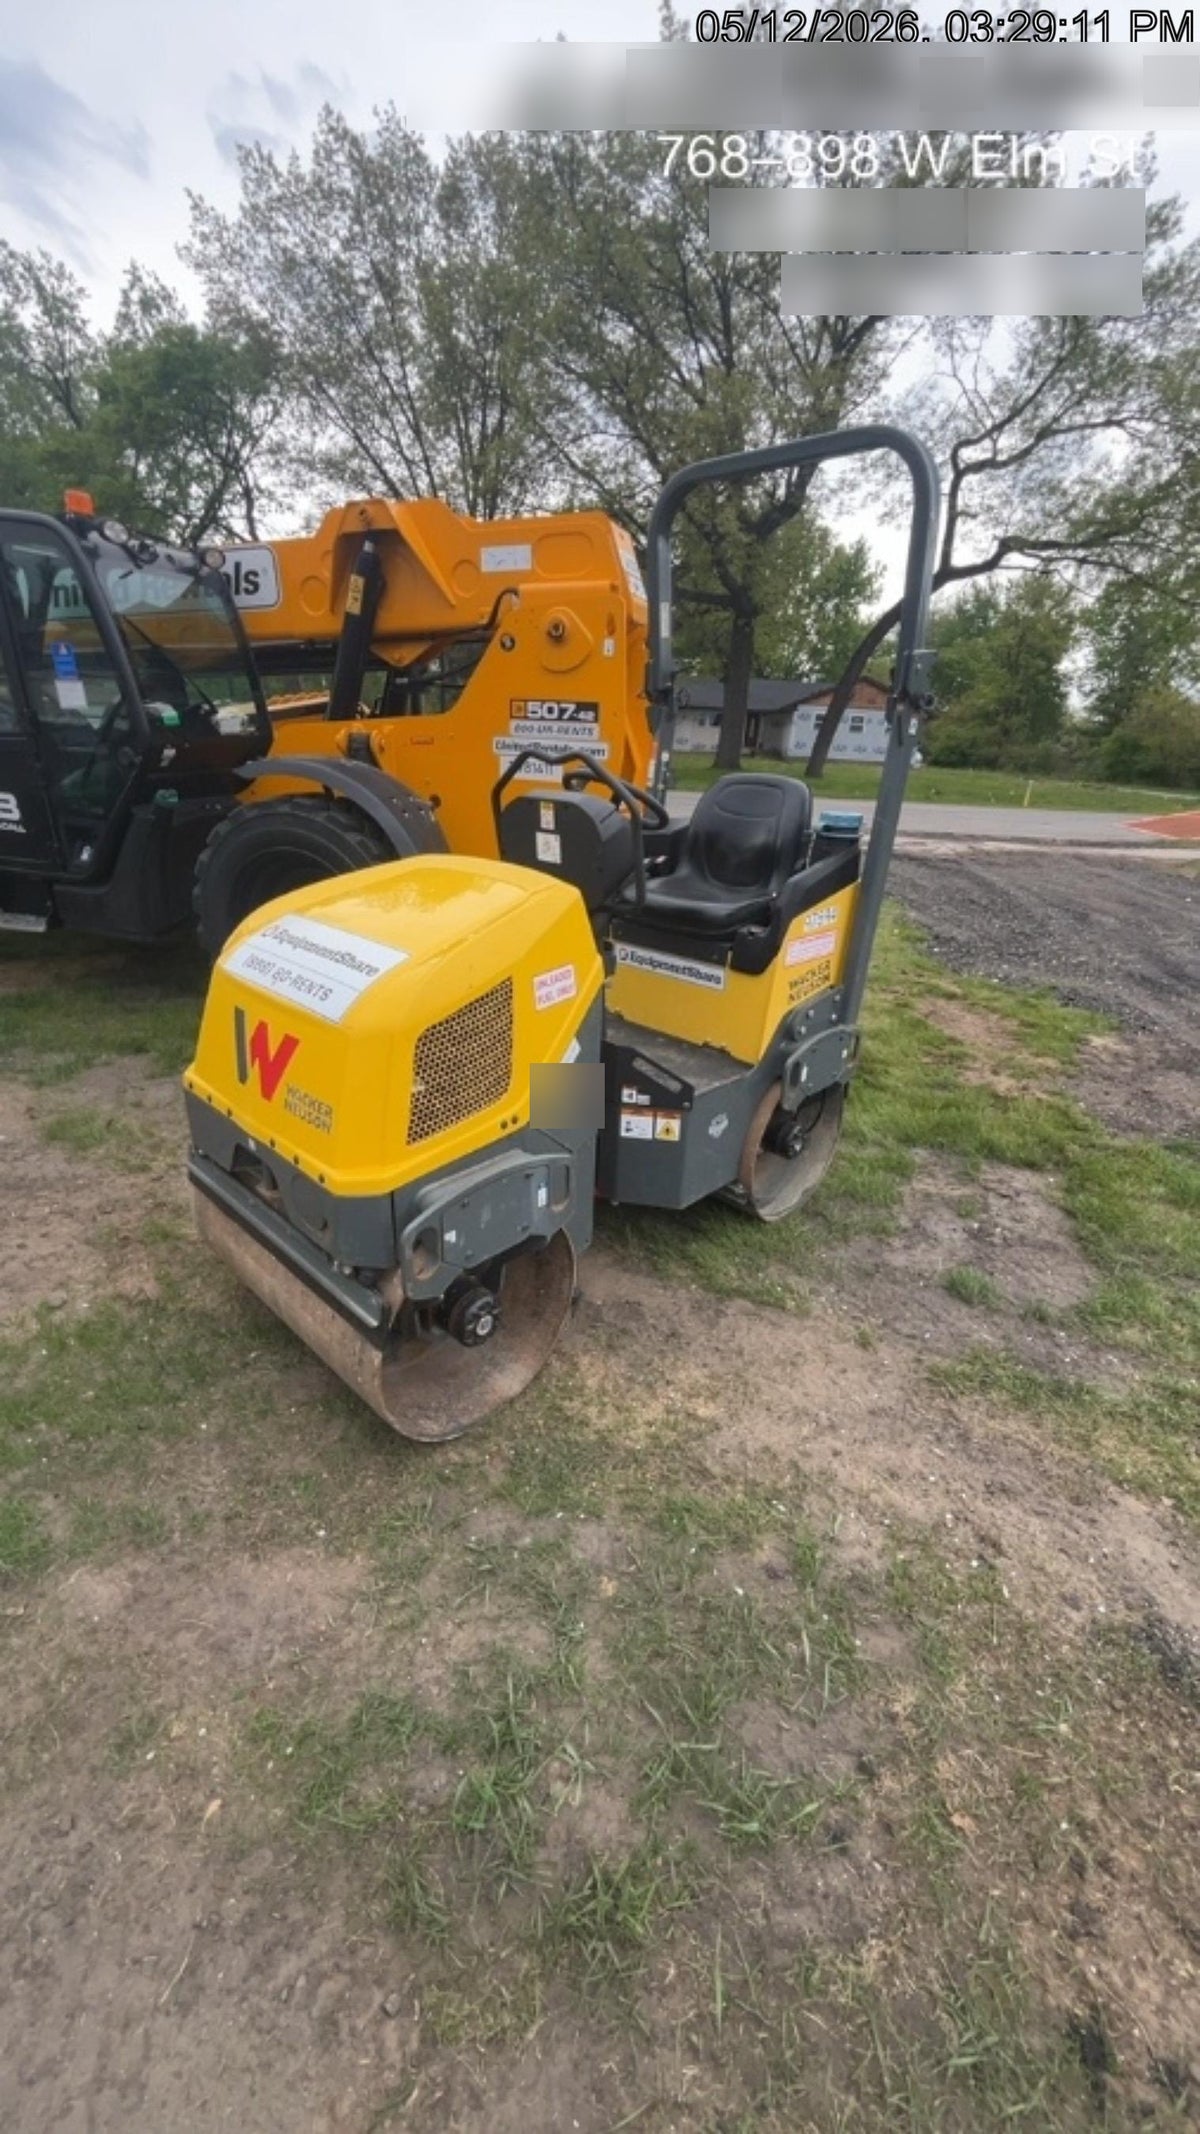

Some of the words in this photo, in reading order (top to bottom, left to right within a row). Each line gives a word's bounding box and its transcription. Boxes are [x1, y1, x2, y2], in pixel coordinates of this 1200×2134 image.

[272, 926, 380, 977] EquipmentShare
[629, 950, 722, 985] EquipmentShare
[284, 1098, 333, 1134] NEUSON
[286, 1084, 334, 1117] WACKER
